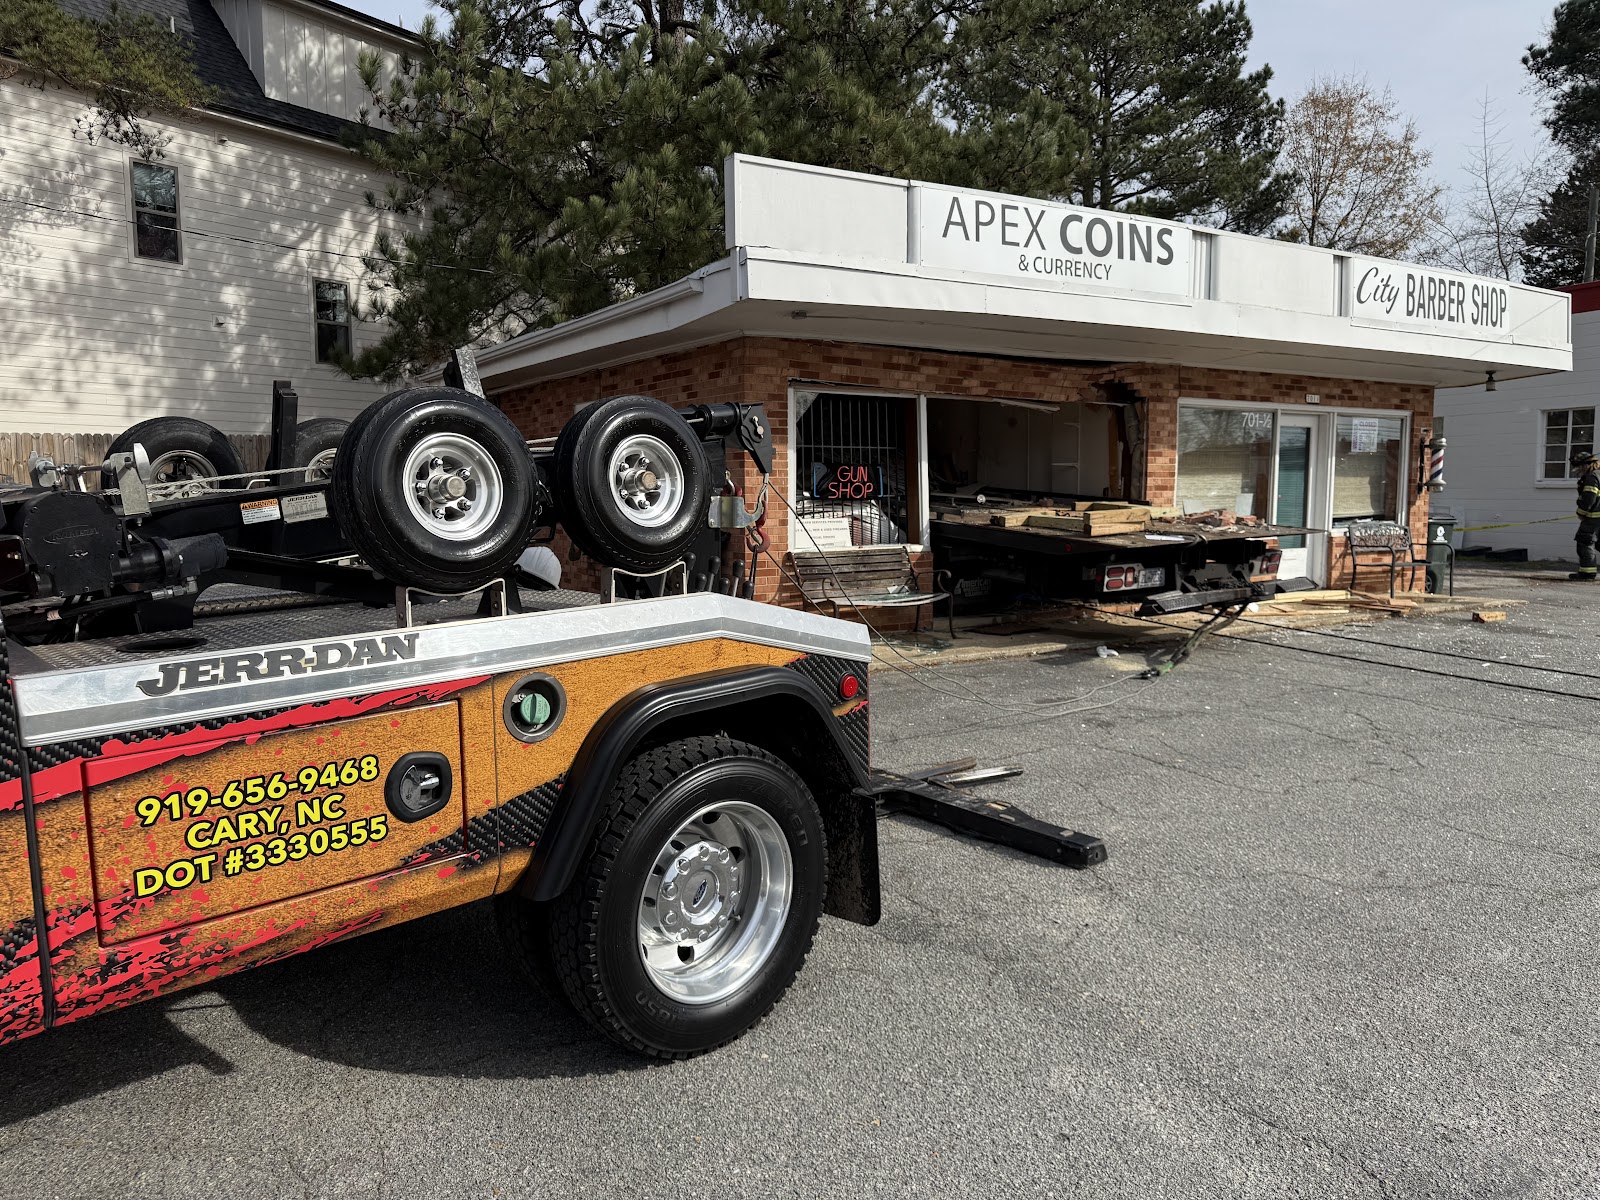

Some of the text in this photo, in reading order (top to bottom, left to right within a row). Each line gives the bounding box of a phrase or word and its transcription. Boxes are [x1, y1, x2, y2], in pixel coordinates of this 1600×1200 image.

[942, 196, 1175, 267] APEX COINS
[1018, 254, 1113, 281] & CURRENCY
[1356, 266, 1507, 329] City BARBER SHOP
[828, 481, 874, 499] SHOP
[837, 465, 868, 483] GUN
[247, 499, 278, 509] WARNING
[136, 632, 420, 697] JERR-DAN
[137, 756, 380, 825] 919-656-9468
[186, 794, 346, 850] CARY, NC
[136, 816, 388, 898] DOT #3330555
